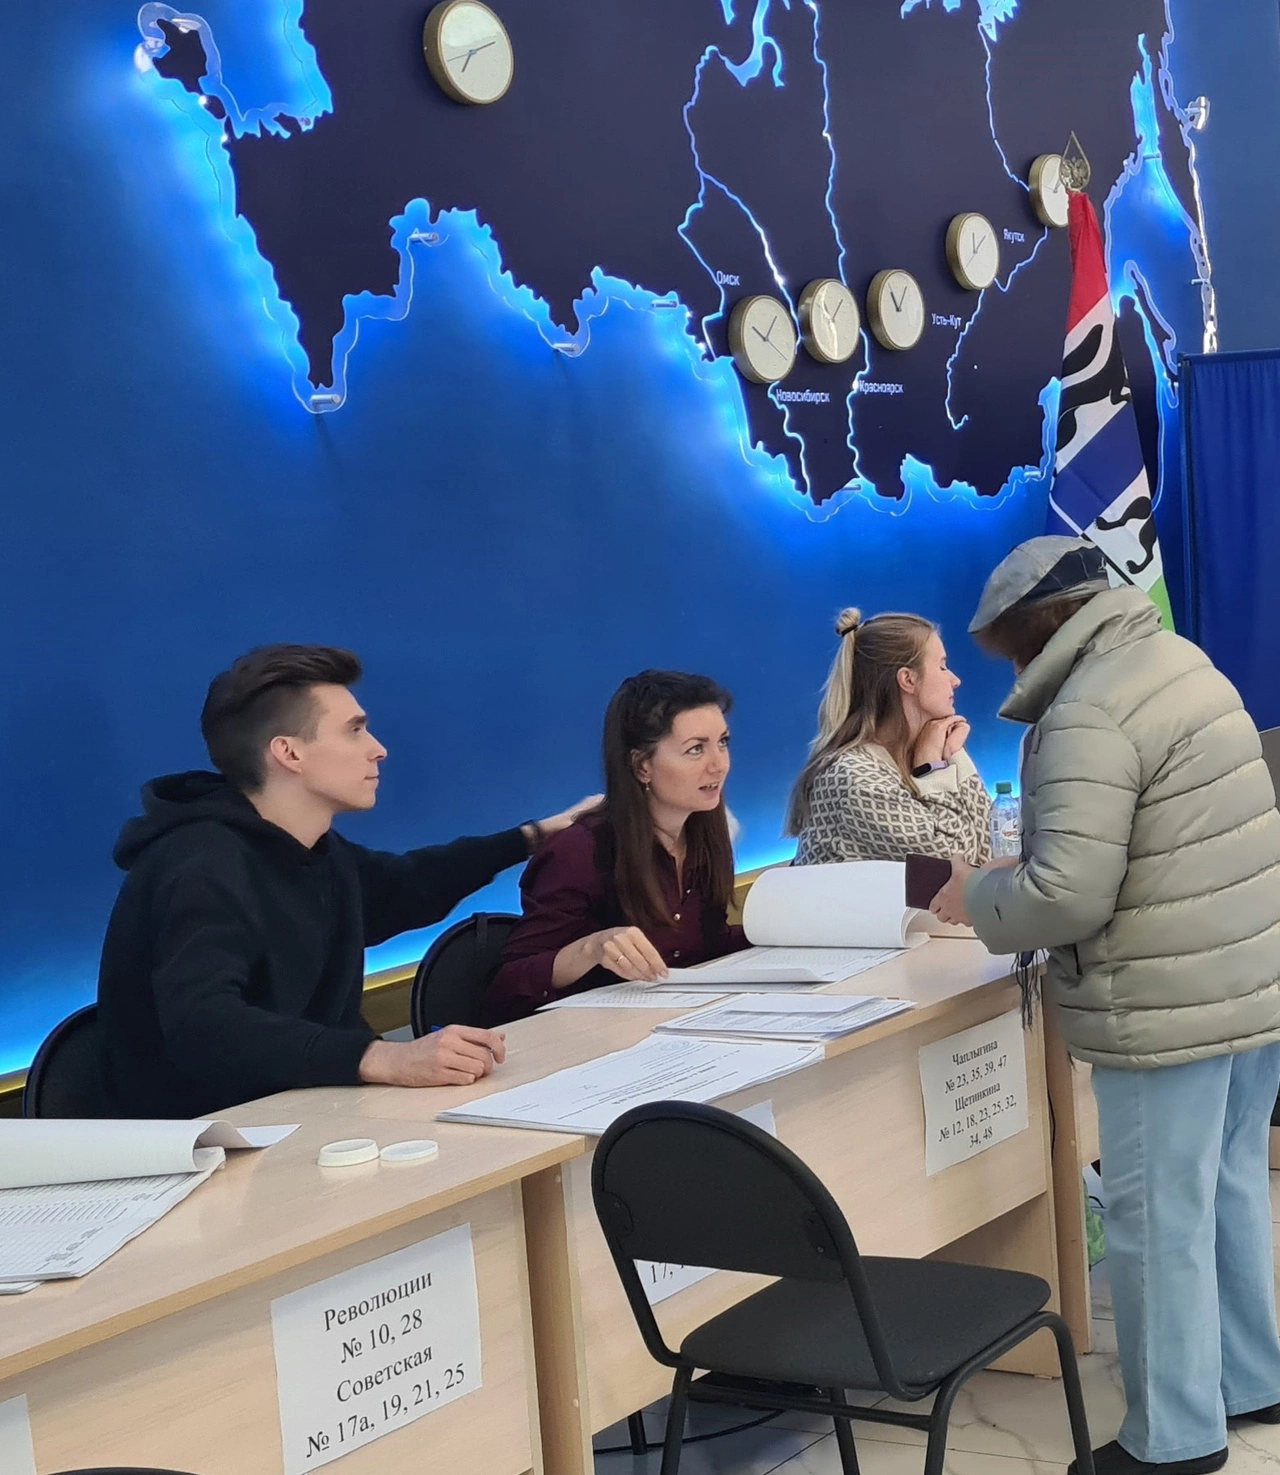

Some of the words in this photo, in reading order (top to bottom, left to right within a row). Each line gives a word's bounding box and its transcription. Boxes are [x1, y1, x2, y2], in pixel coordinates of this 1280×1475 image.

[716, 270, 740, 286] Омск
[776, 389, 831, 405] Новосибирск
[859, 380, 904, 395] Красноярск
[952, 1040, 998, 1066] Чаплыгина
[956, 1073, 969, 1089] 23,
[970, 1067, 983, 1082] 35,
[984, 1061, 996, 1076] 39,
[997, 1055, 1007, 1068] 47
[954, 1082, 1001, 1112] Щетинкина
[983, 1126, 993, 1140] 48
[323, 1272, 433, 1332] Революции
[340, 1337, 363, 1364] №
[370, 1323, 396, 1350] 10,
[400, 1308, 423, 1335] 28
[336, 1346, 433, 1402] Советская
[306, 1431, 330, 1458] №
[337, 1414, 375, 1442] 17а,
[382, 1394, 408, 1420] 19,
[412, 1379, 440, 1405] 21,
[443, 1362, 466, 1389] 25
